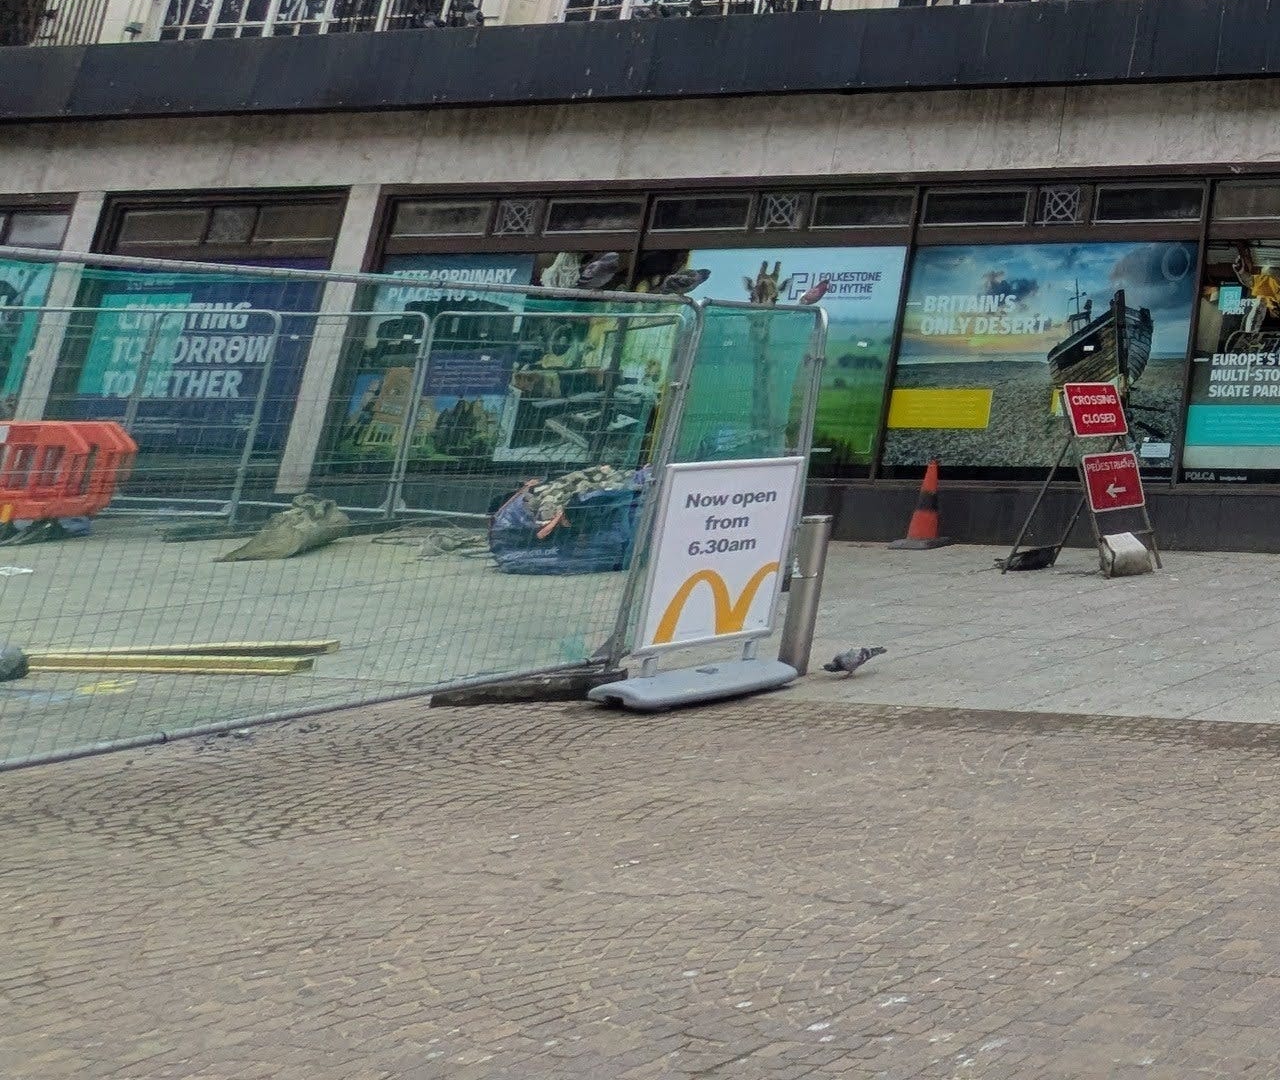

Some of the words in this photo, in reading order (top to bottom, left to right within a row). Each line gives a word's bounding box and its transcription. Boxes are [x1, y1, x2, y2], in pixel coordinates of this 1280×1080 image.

[818, 272, 882, 282] FOLKESTONE
[839, 283, 874, 294] HYTHE
[922, 294, 1017, 313] BRITAIN'S
[920, 317, 969, 336] ONLY
[973, 316, 1050, 335] DESERT
[1212, 352, 1276, 366] EUROPE'S
[1208, 384, 1251, 398] SKATE
[1072, 394, 1117, 406] CROSSING
[1082, 413, 1116, 424] CLOSED
[1085, 459, 1136, 473] PEDESTRIANS
[1184, 471, 1216, 481] FOLCA
[685, 492, 729, 509] Now
[731, 490, 778, 508] open
[704, 514, 750, 531] from
[687, 536, 757, 557] 6.30am
